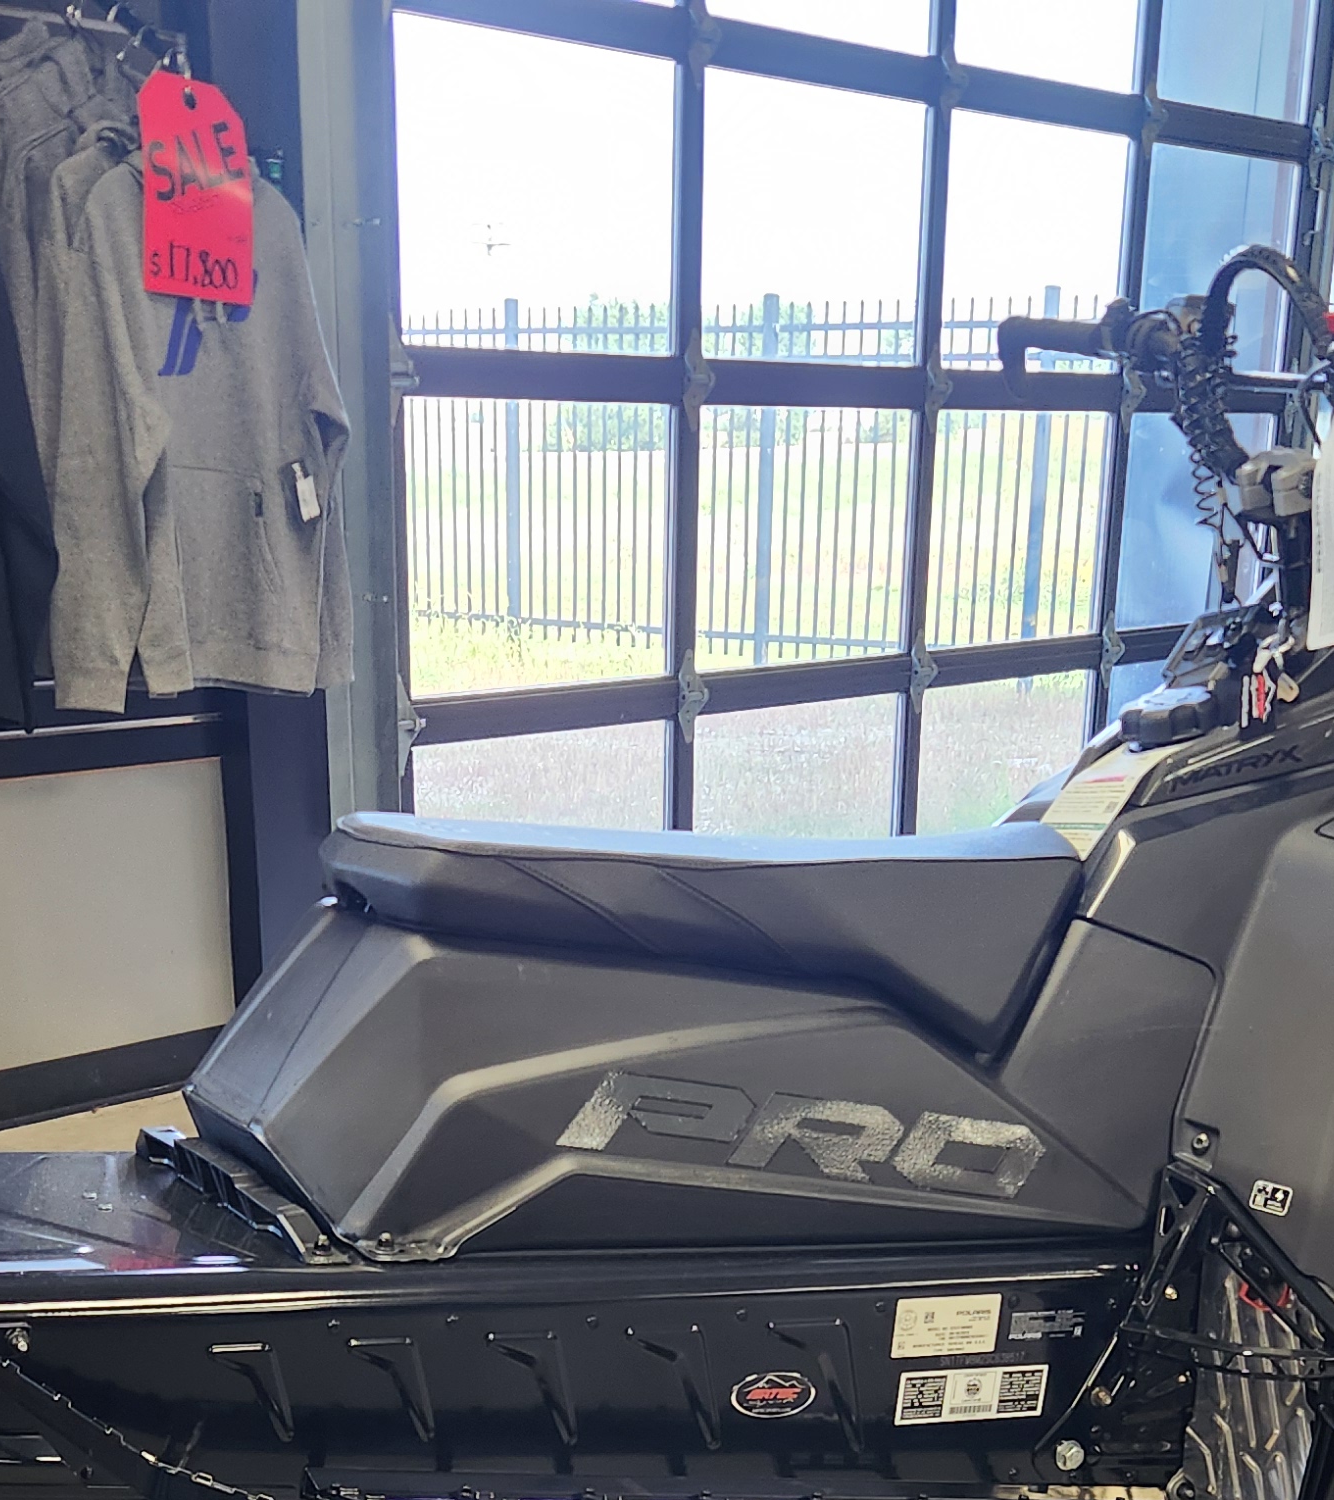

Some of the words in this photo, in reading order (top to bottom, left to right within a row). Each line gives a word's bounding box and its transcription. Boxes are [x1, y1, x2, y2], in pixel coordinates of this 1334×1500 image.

[148, 121, 244, 201] SALE
[1169, 744, 1304, 794] MATRYX
[555, 1069, 1048, 1200] PRO
